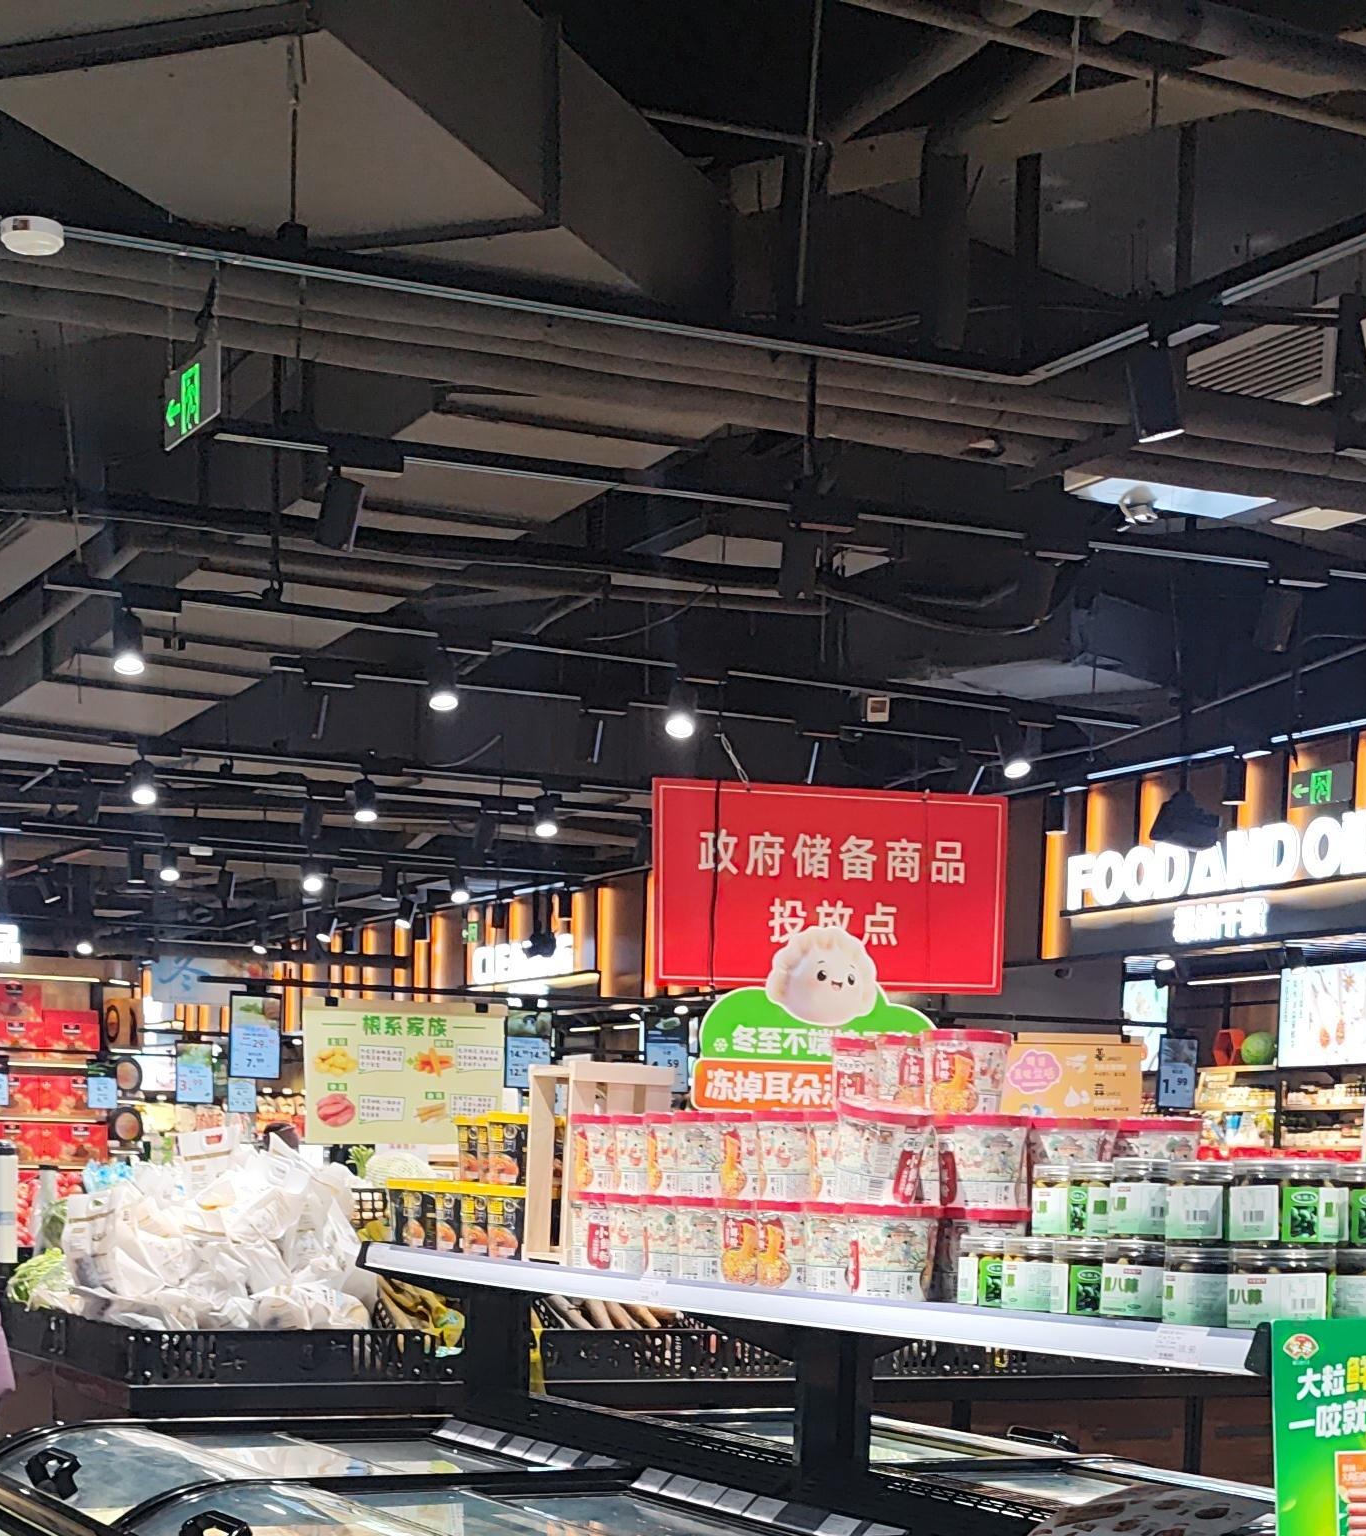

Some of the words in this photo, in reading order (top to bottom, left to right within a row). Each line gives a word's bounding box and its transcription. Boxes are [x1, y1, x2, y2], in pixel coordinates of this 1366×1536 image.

[698, 828, 967, 884] 政府储备商品
[1066, 840, 1188, 910] FOOD
[1187, 822, 1300, 894] AND
[362, 1014, 448, 1037] 根系家族
[705, 1068, 833, 1104] 冻掉耳朵
